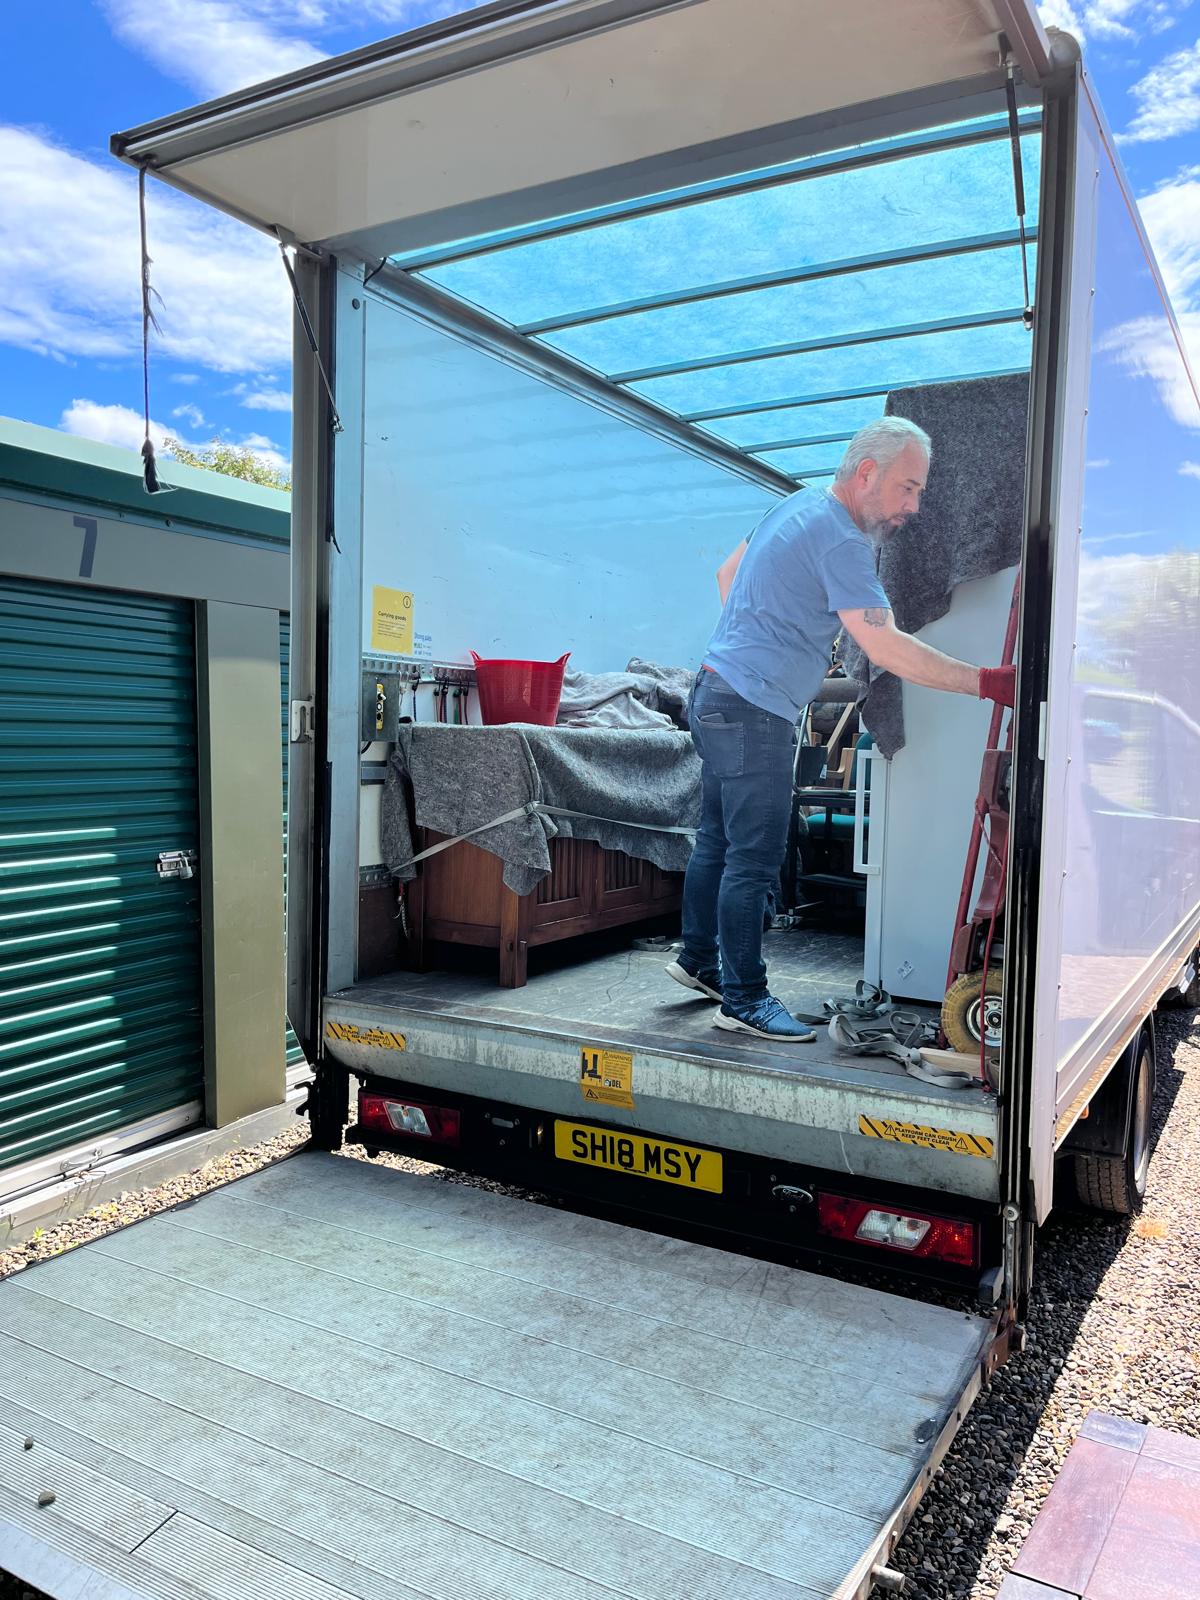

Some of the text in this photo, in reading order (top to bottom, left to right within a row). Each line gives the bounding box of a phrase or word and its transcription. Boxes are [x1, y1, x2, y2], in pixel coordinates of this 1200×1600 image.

[73, 515, 98, 578] 7
[572, 1129, 701, 1182] SH18 MSY
[895, 1127, 923, 1135] PLATFORM
[938, 1134, 957, 1142] CRUSH
